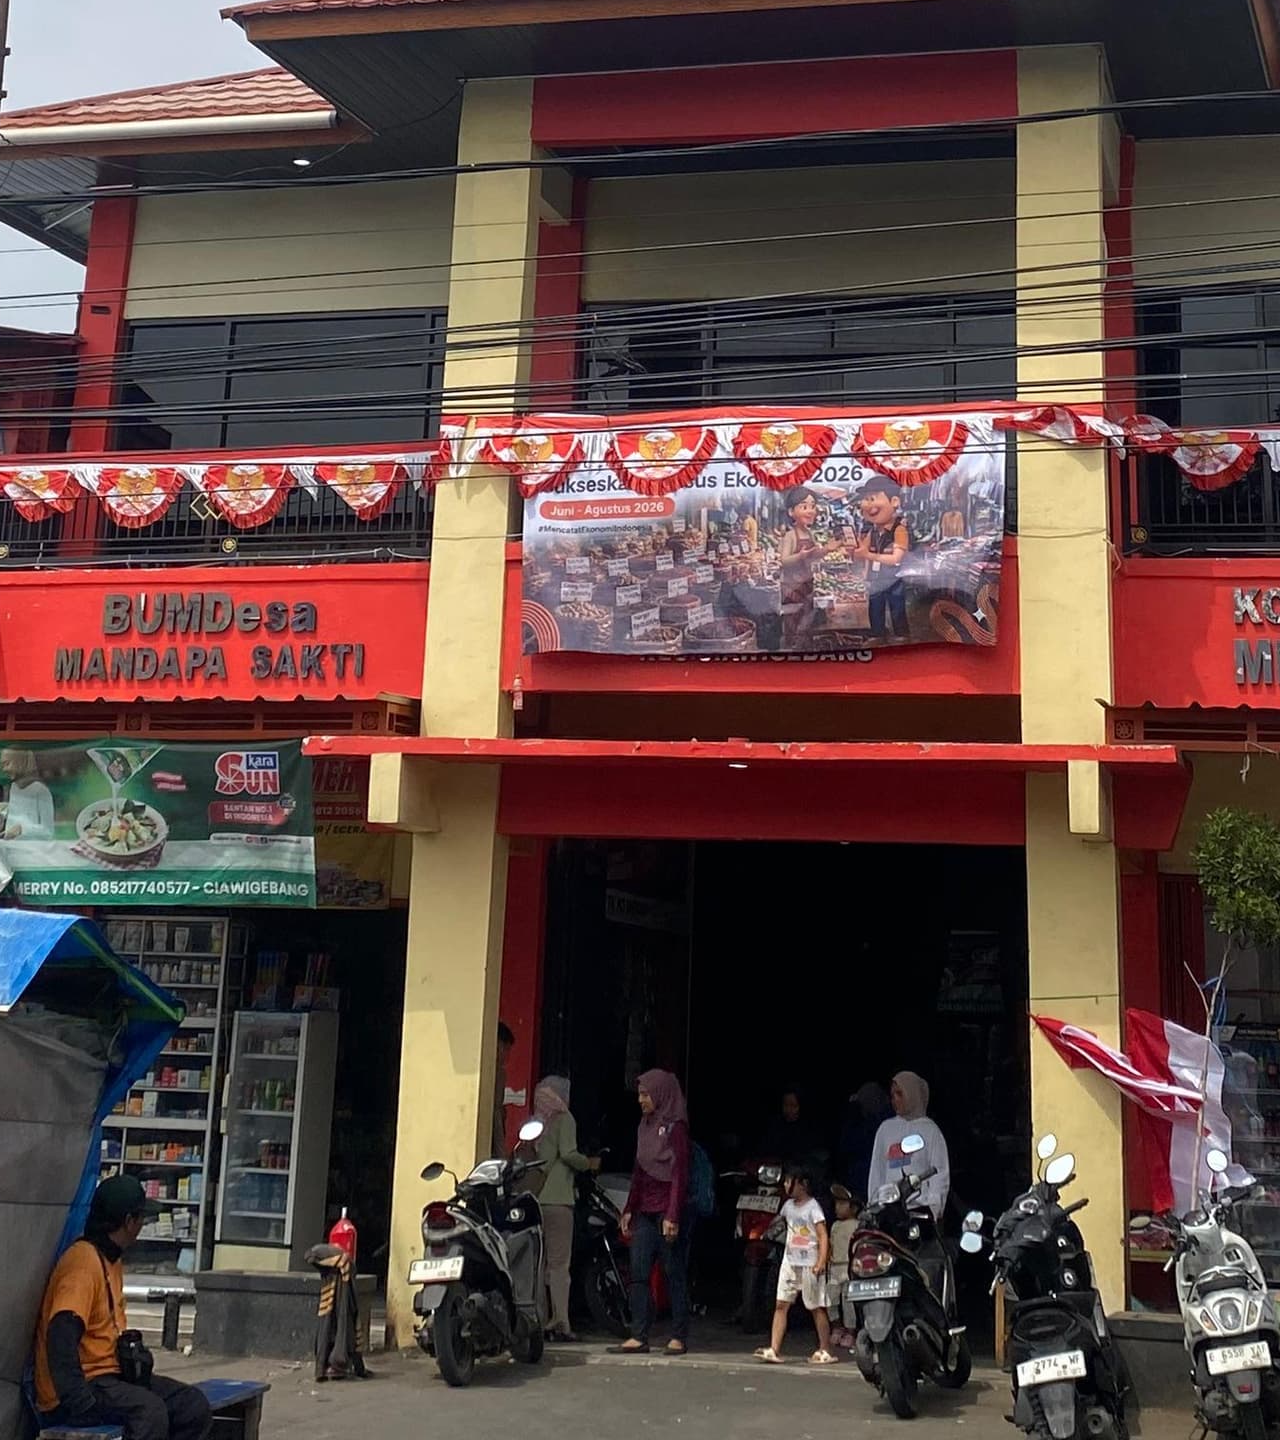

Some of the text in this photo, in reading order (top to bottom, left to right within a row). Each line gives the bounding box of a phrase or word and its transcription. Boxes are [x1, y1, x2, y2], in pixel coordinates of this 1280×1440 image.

[812, 465, 863, 483] 2026
[550, 505, 574, 517] Juni
[584, 504, 631, 517] Agustus
[633, 502, 664, 515] 2026
[102, 591, 318, 635] BUMDesa
[55, 642, 366, 682] MANDAPA SAKTI
[248, 753, 276, 768] kara
[63, 881, 89, 896] No.
[91, 881, 189, 896] 085217740577
[203, 881, 310, 897] CIAWIGEBANG
